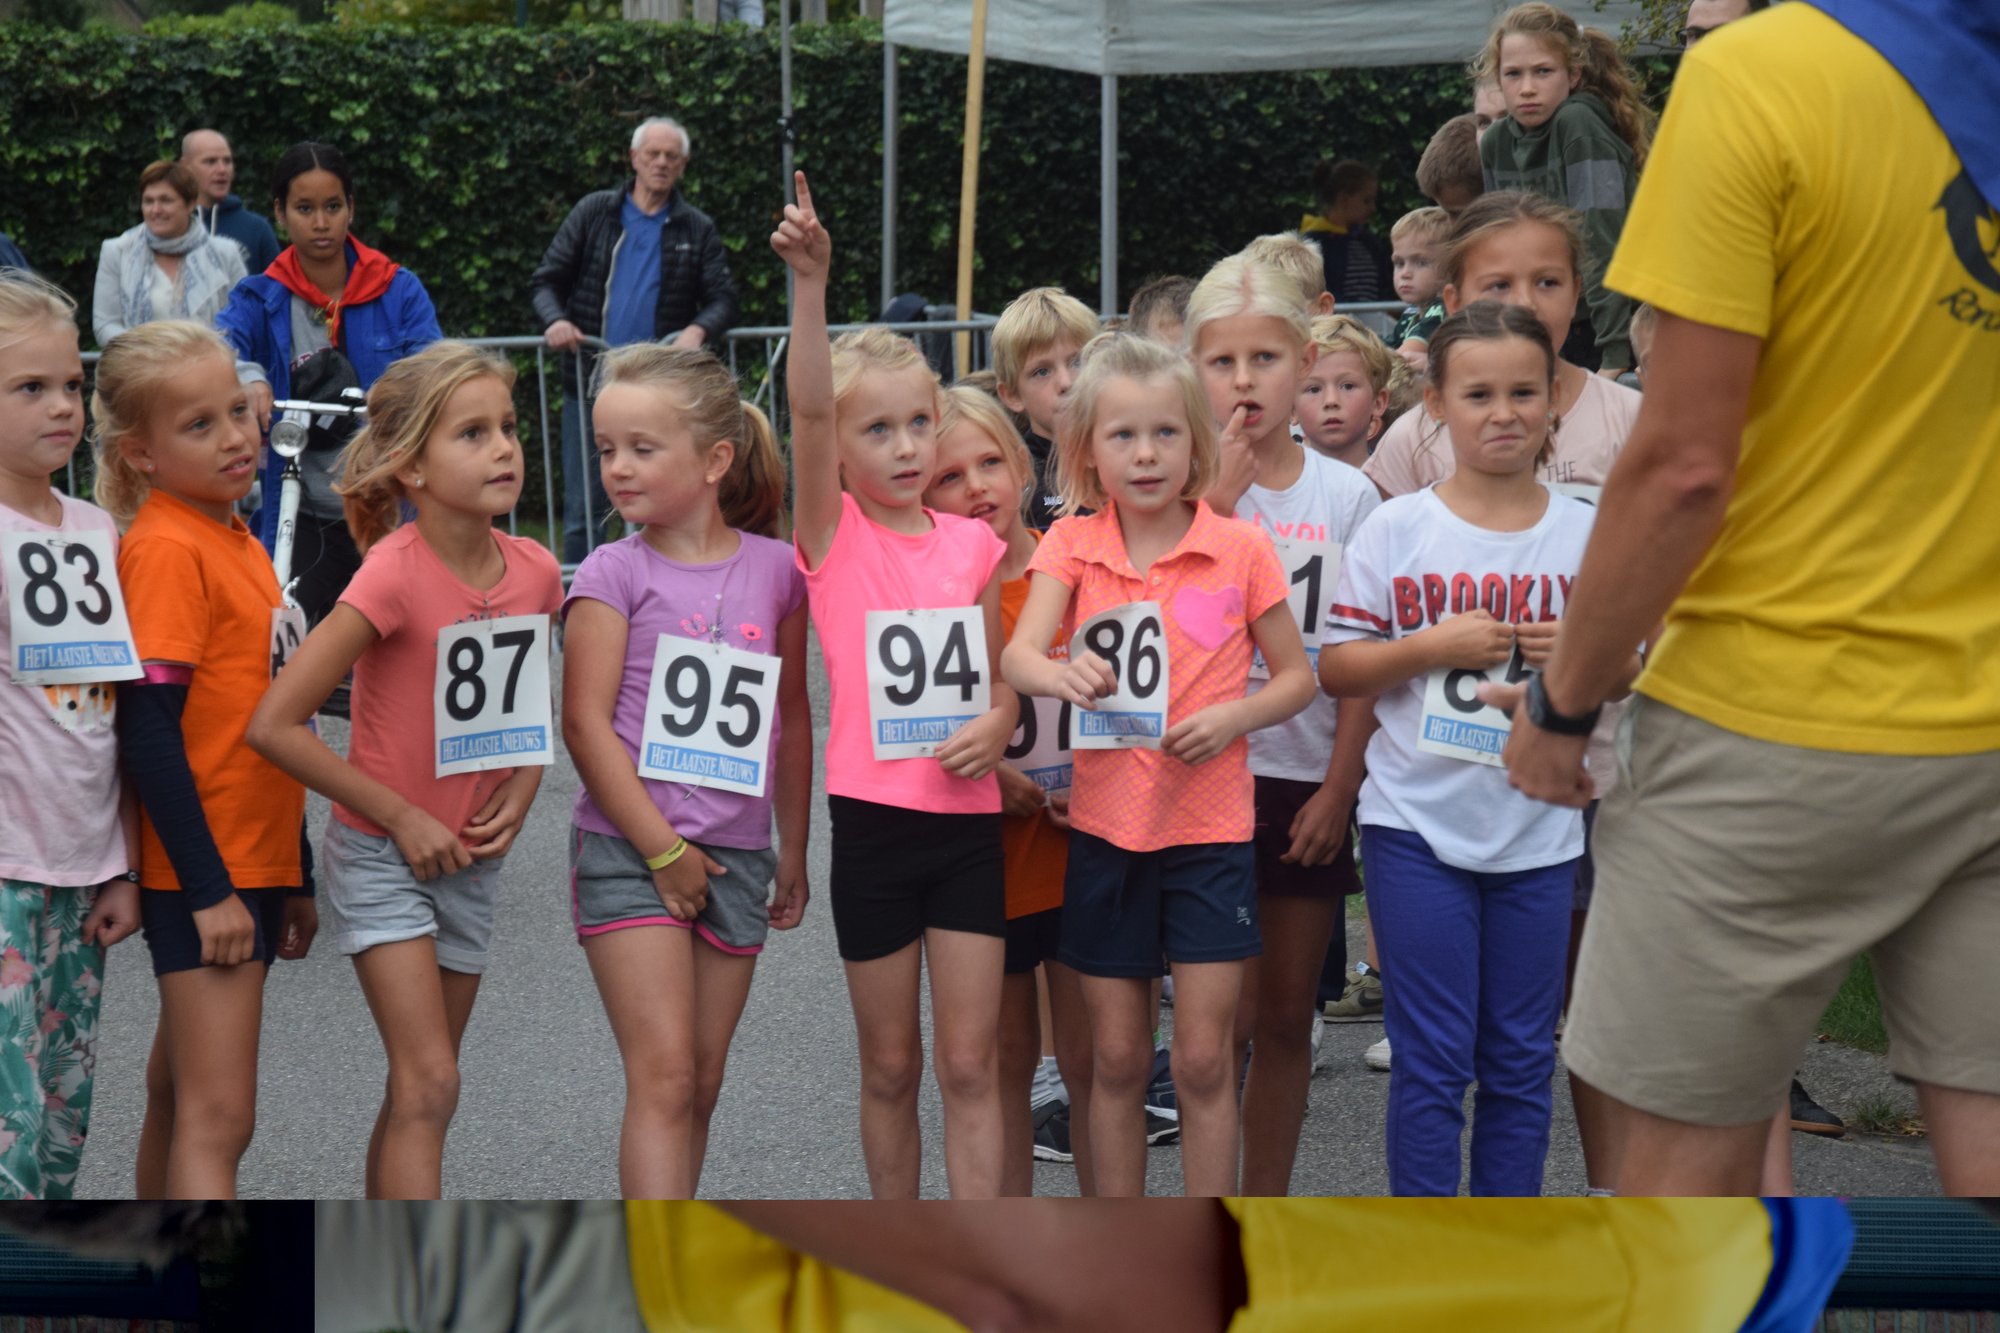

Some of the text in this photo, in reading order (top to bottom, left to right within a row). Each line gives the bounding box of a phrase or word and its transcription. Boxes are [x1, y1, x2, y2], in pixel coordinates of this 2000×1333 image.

[1544, 461, 1576, 483] THE
[18, 541, 113, 627] 83
[1291, 555, 1323, 634] 1
[1393, 572, 1578, 630] BROOKLY
[48, 644, 93, 667] LAATSTE
[91, 643, 128, 665] NIEUWS
[445, 629, 536, 722] 87
[879, 621, 980, 706] 94
[1085, 616, 1162, 699] 86
[661, 655, 765, 748] 95
[460, 735, 500, 758] LAATSTE
[502, 731, 541, 753] NIEUWS
[883, 721, 903, 743] HET
[903, 720, 947, 741] LAATSTE
[1428, 717, 1452, 740] HET
[1451, 720, 1497, 751] LAATSTE
[651, 746, 755, 783] HET LAATSTE NIEUWS
